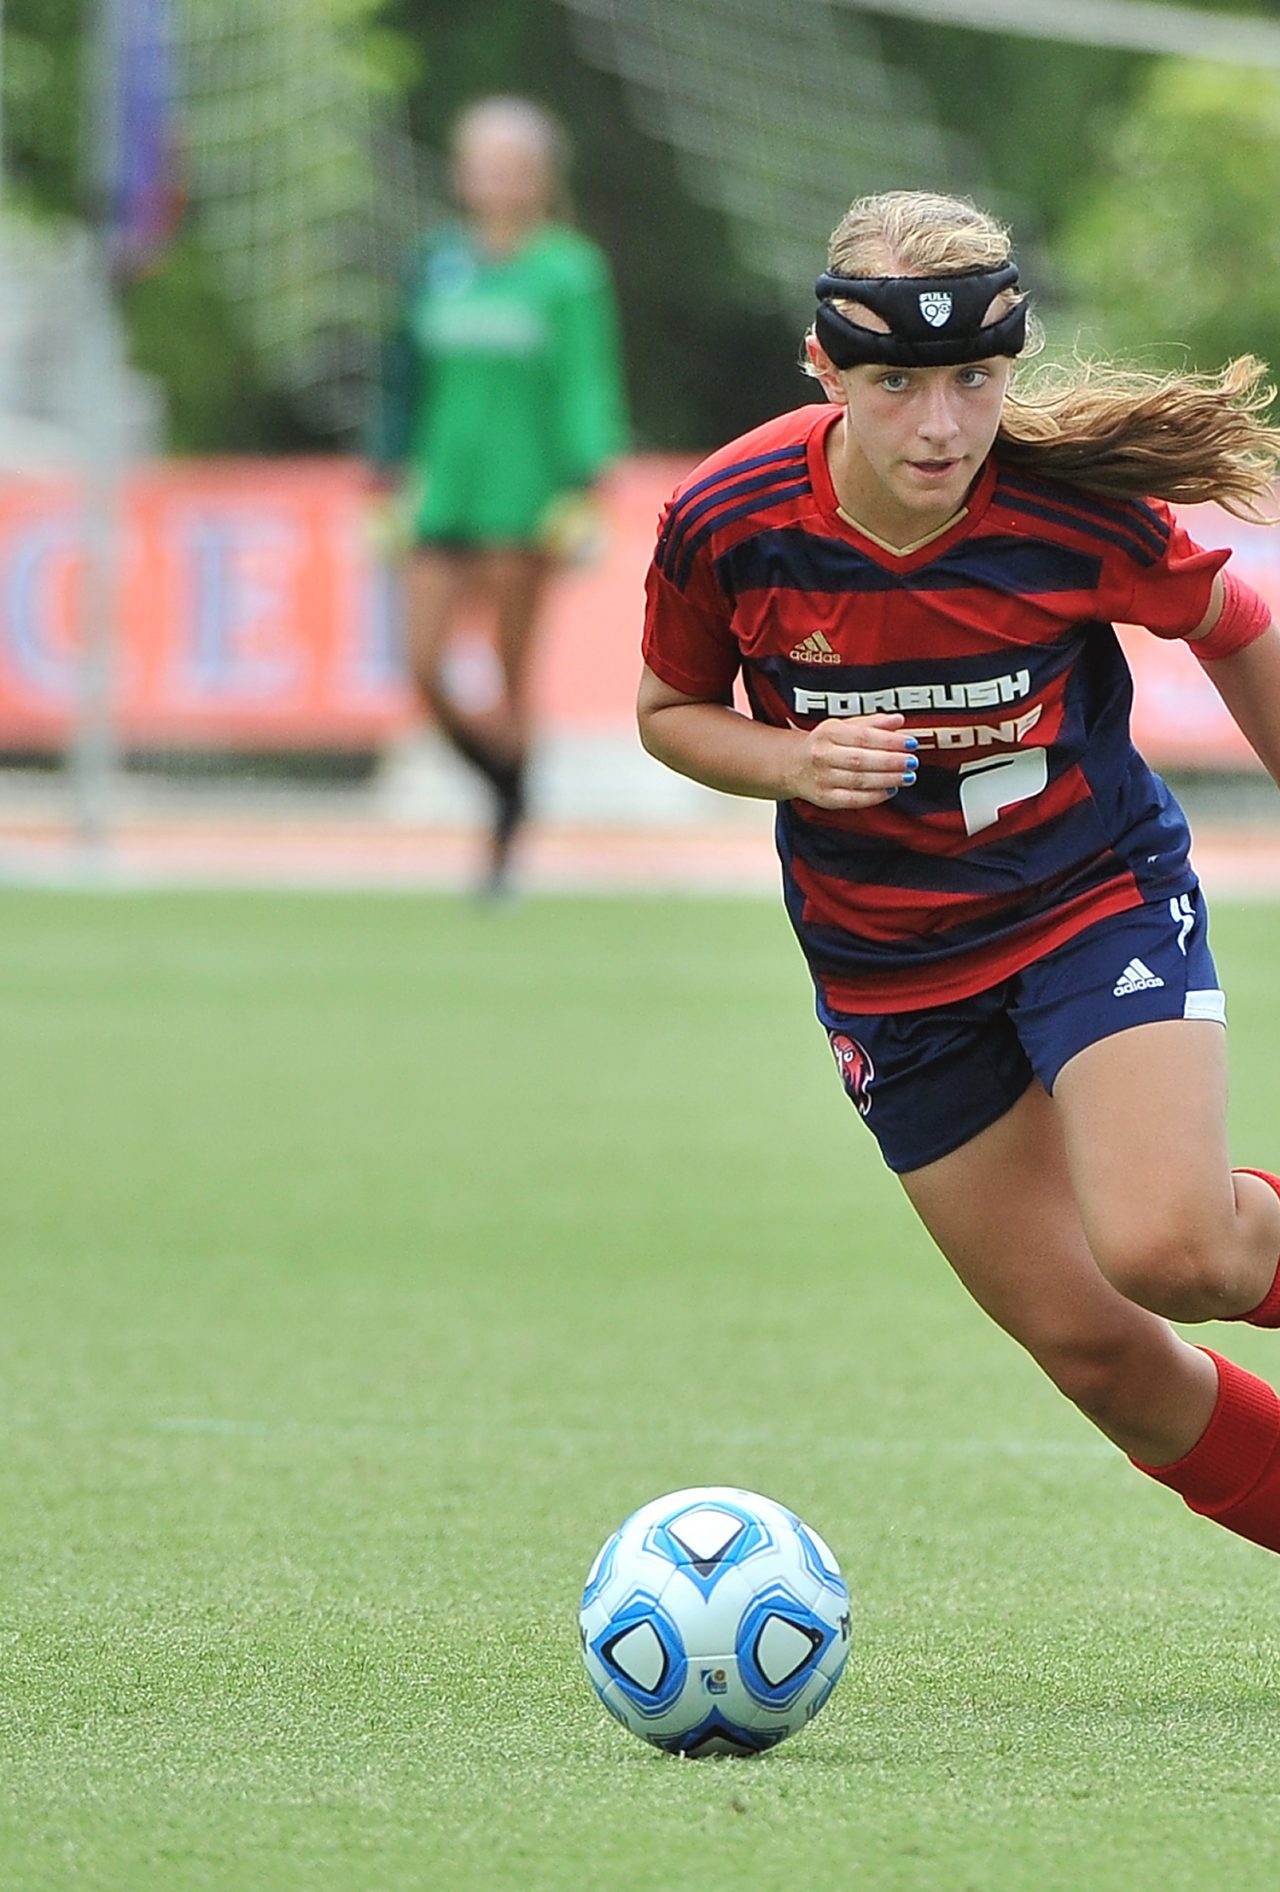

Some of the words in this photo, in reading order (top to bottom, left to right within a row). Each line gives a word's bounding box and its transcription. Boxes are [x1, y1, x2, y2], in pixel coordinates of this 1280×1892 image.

[789, 650, 841, 664] adidas
[793, 668, 1031, 717] FORBUSH
[1113, 977, 1165, 997] adidas
